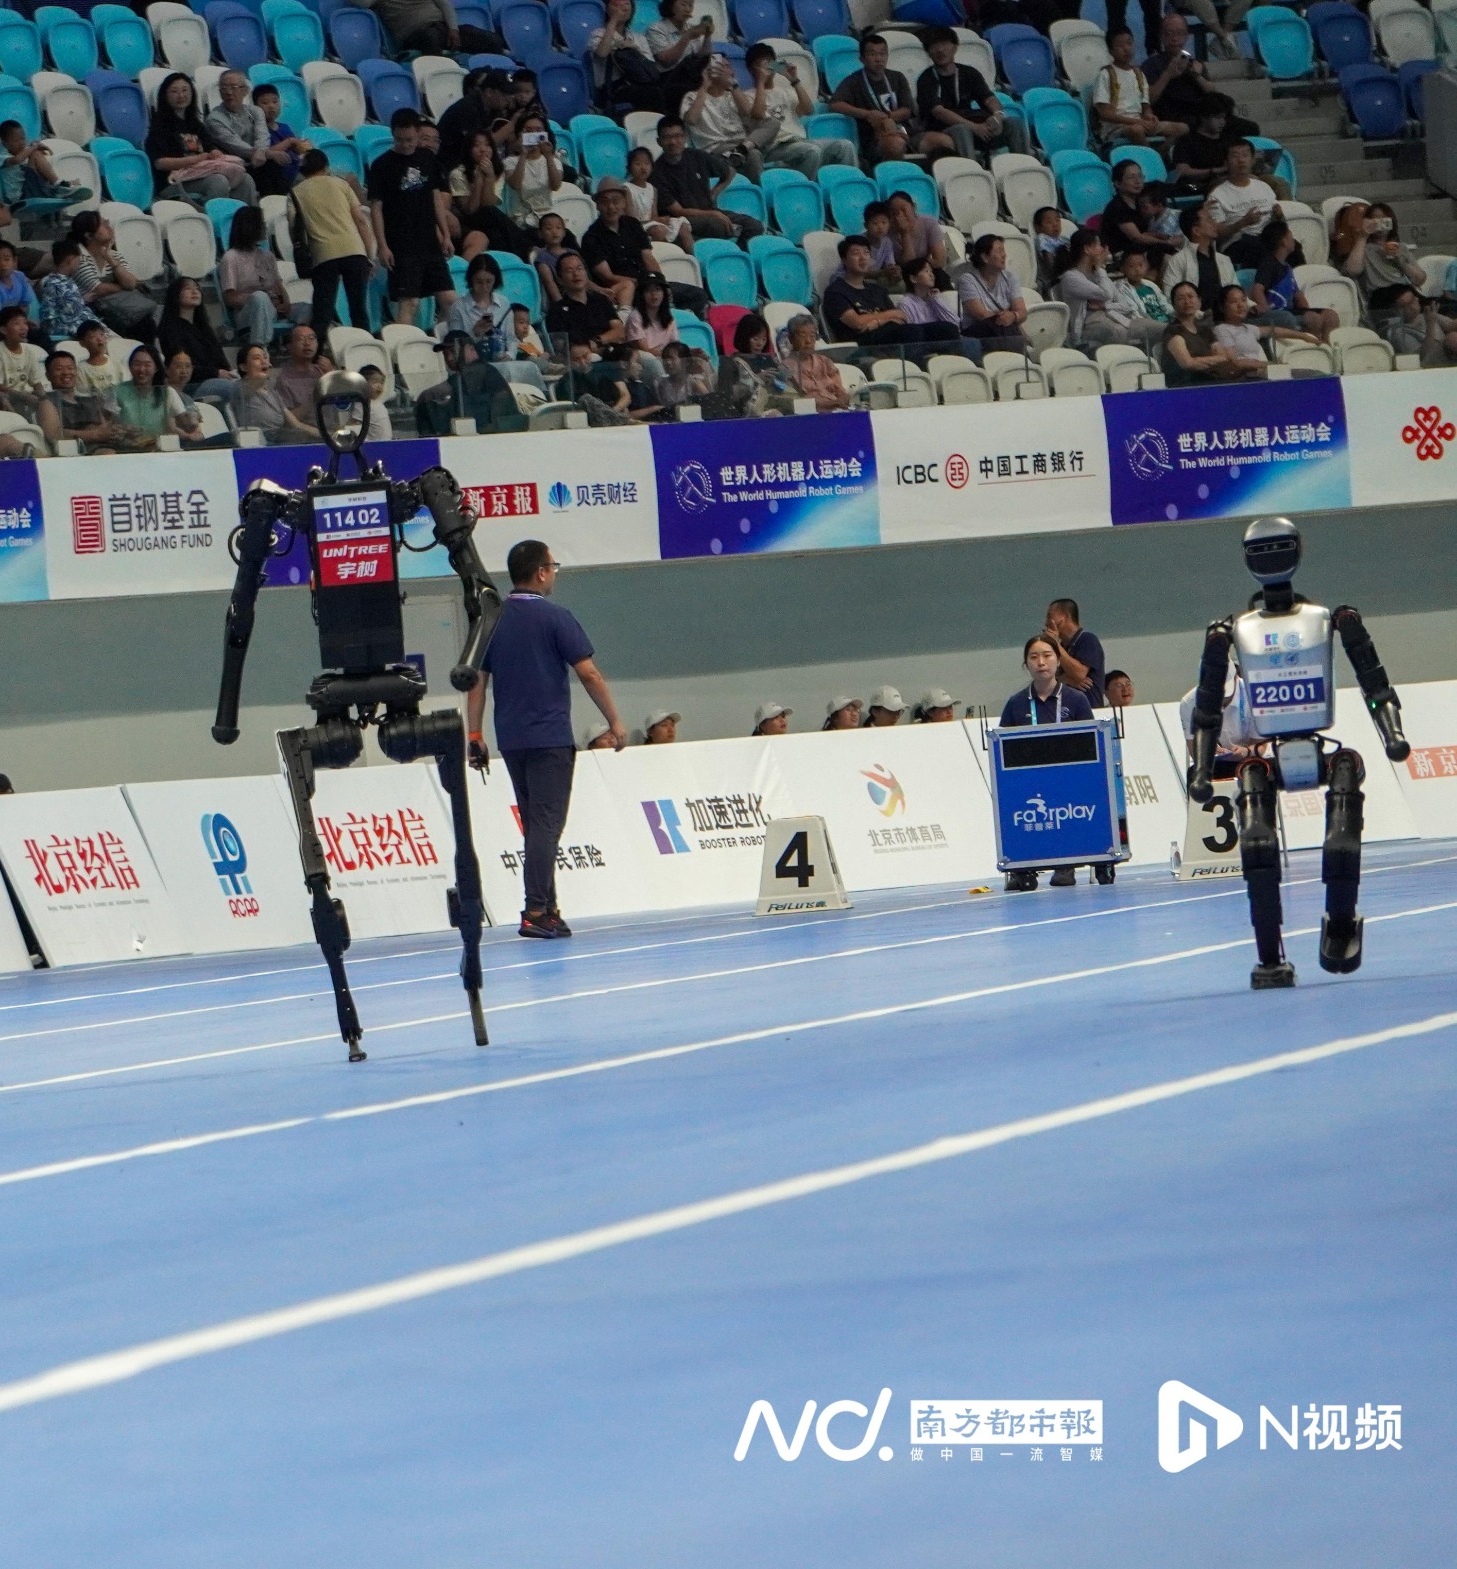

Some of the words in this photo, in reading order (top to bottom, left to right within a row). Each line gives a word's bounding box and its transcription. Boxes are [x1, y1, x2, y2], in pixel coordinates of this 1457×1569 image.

[1177, 422, 1332, 453] 世界人形机器人运动会
[979, 449, 1085, 480] 中国工商银行
[1179, 458, 1197, 470] The
[1198, 455, 1225, 468] World
[1226, 450, 1272, 466] Humanoid
[1273, 450, 1300, 462] Robot
[1301, 448, 1334, 460] Games
[720, 458, 862, 486] 世界人形机器人运动会
[896, 464, 940, 486] ICBC
[465, 485, 533, 517] 新京报
[576, 482, 638, 508] 贝壳财经
[722, 491, 738, 503] The
[739, 489, 764, 502] World
[765, 486, 807, 500] Humanoid
[808, 486, 834, 498] Robot
[835, 484, 864, 496] Games
[108, 490, 211, 534] 首钢基金
[323, 507, 380, 528] 11402
[406, 515, 430, 525] ames
[8, 536, 33, 547] Games
[112, 537, 178, 553] SHOUGANG
[180, 534, 213, 549] FUND
[322, 543, 388, 558] UNITREE
[336, 560, 378, 579] 宇树
[1255, 683, 1315, 703] 22001
[1411, 747, 1457, 777] 新京
[685, 792, 772, 832] 加速进化
[867, 824, 947, 847] 北京市体育局
[1201, 796, 1240, 853] 3
[318, 807, 438, 873] 北京经信
[698, 837, 738, 850] BOOSTER
[24, 830, 140, 897] 北京经信
[500, 844, 606, 877] 中民保险
[775, 831, 814, 888] 4
[229, 897, 260, 919] RCAP
